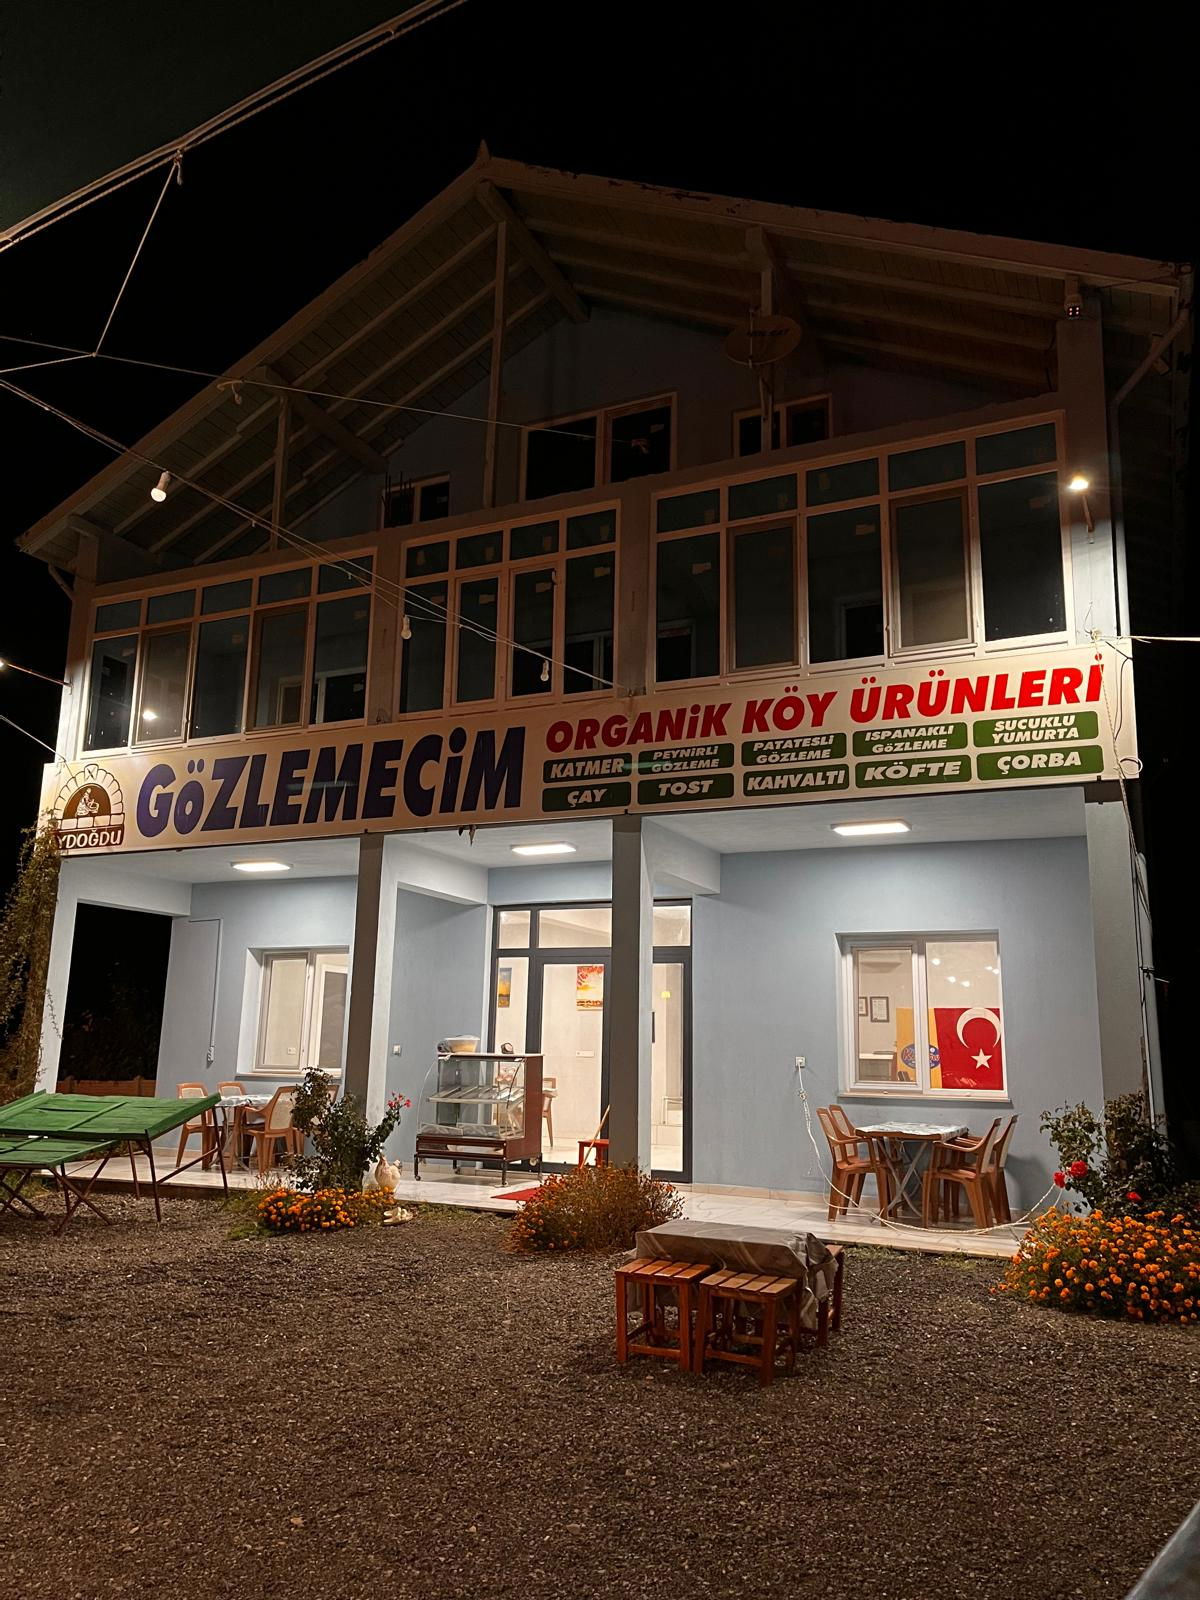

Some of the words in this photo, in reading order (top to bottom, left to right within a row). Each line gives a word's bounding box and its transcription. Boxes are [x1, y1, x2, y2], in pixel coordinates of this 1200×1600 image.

[741, 685, 838, 734] KÖY
[850, 654, 1104, 723] ÜRÜNLERİ
[865, 725, 954, 741] ISPANAKLI
[994, 715, 1076, 732] SUCUKLU
[992, 727, 1079, 744] YUMURTA
[756, 748, 831, 764] GÖZLEME
[997, 751, 1082, 774] ÇORBA
[550, 758, 625, 778] KATMER
[651, 759, 720, 773] GÖZLEME
[863, 761, 962, 780] KÖFTE
[658, 779, 714, 797] TOST
[747, 769, 845, 791] KAHVALTI
[567, 788, 608, 807] ÇAY
[50, 828, 122, 850] YDOĞDU
